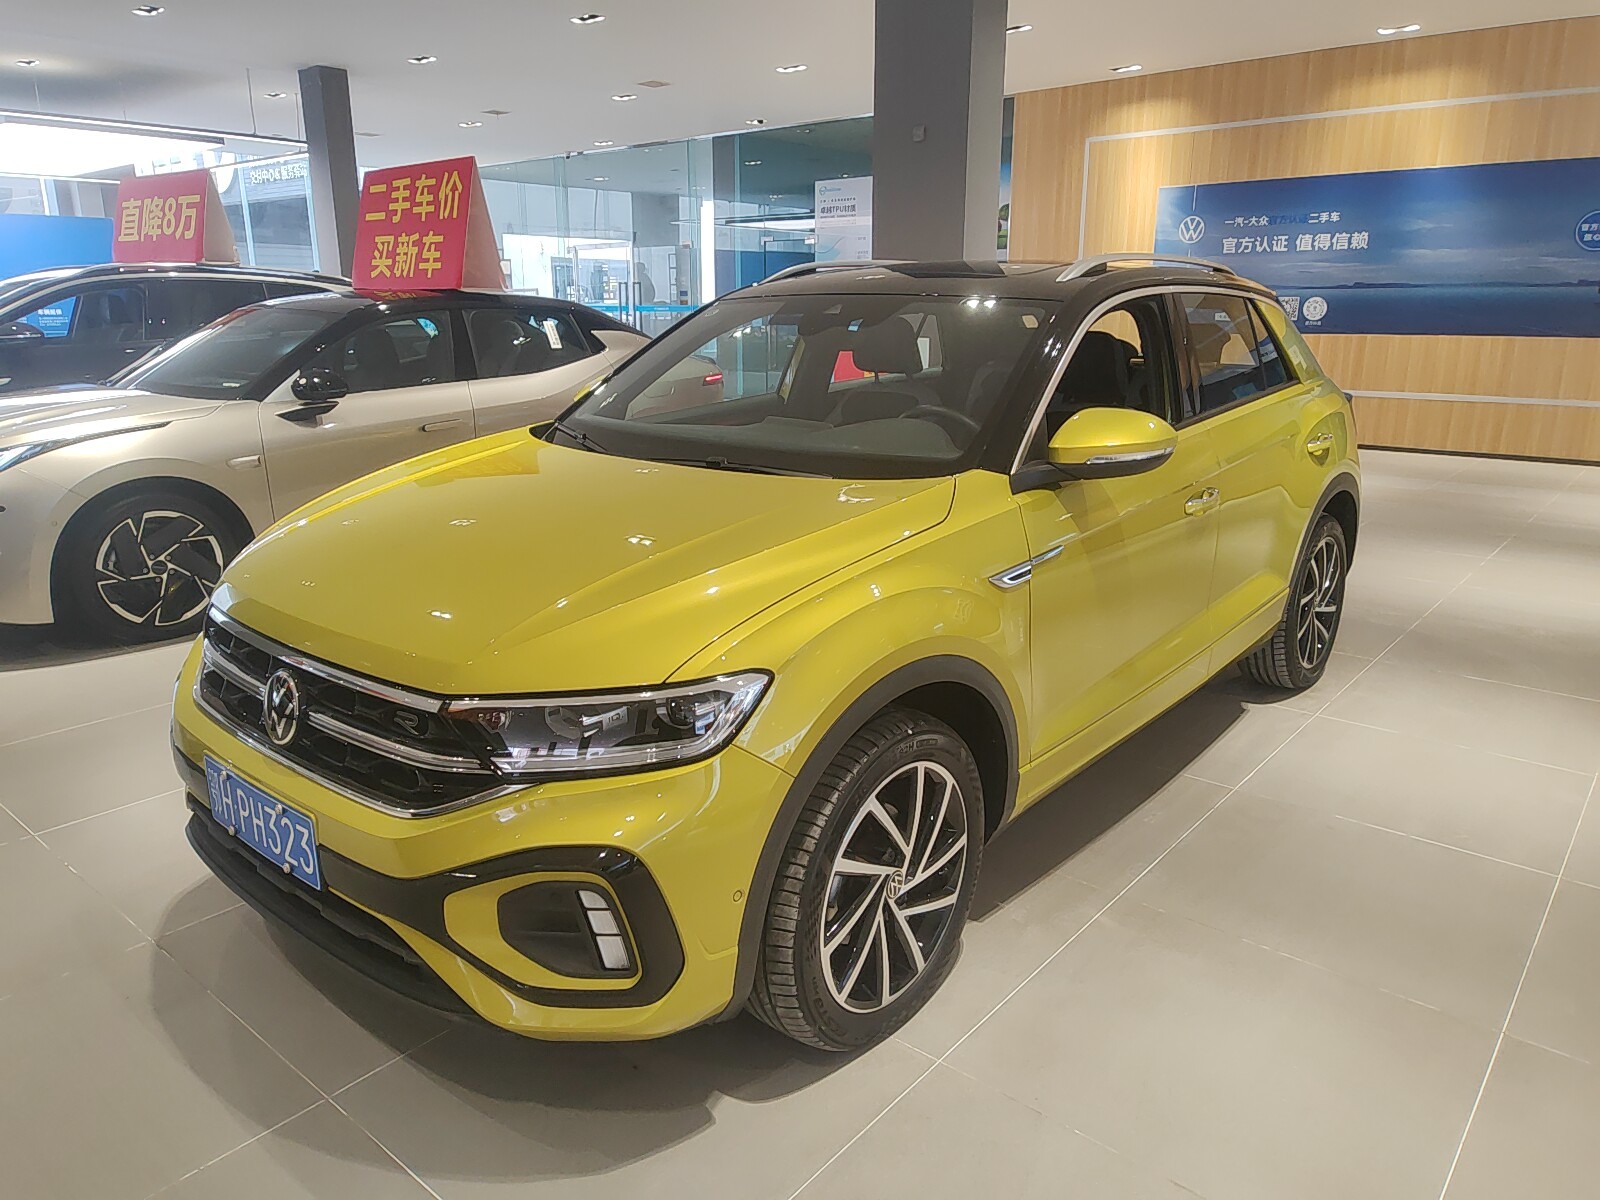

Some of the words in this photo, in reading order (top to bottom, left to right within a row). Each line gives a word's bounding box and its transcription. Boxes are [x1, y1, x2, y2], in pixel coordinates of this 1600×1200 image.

[117, 194, 201, 242] 直降8万
[365, 171, 462, 224] 二手车价
[370, 230, 445, 279] 买新车
[1222, 236, 1289, 254] 官方认证
[1295, 230, 1369, 252] 值得信赖
